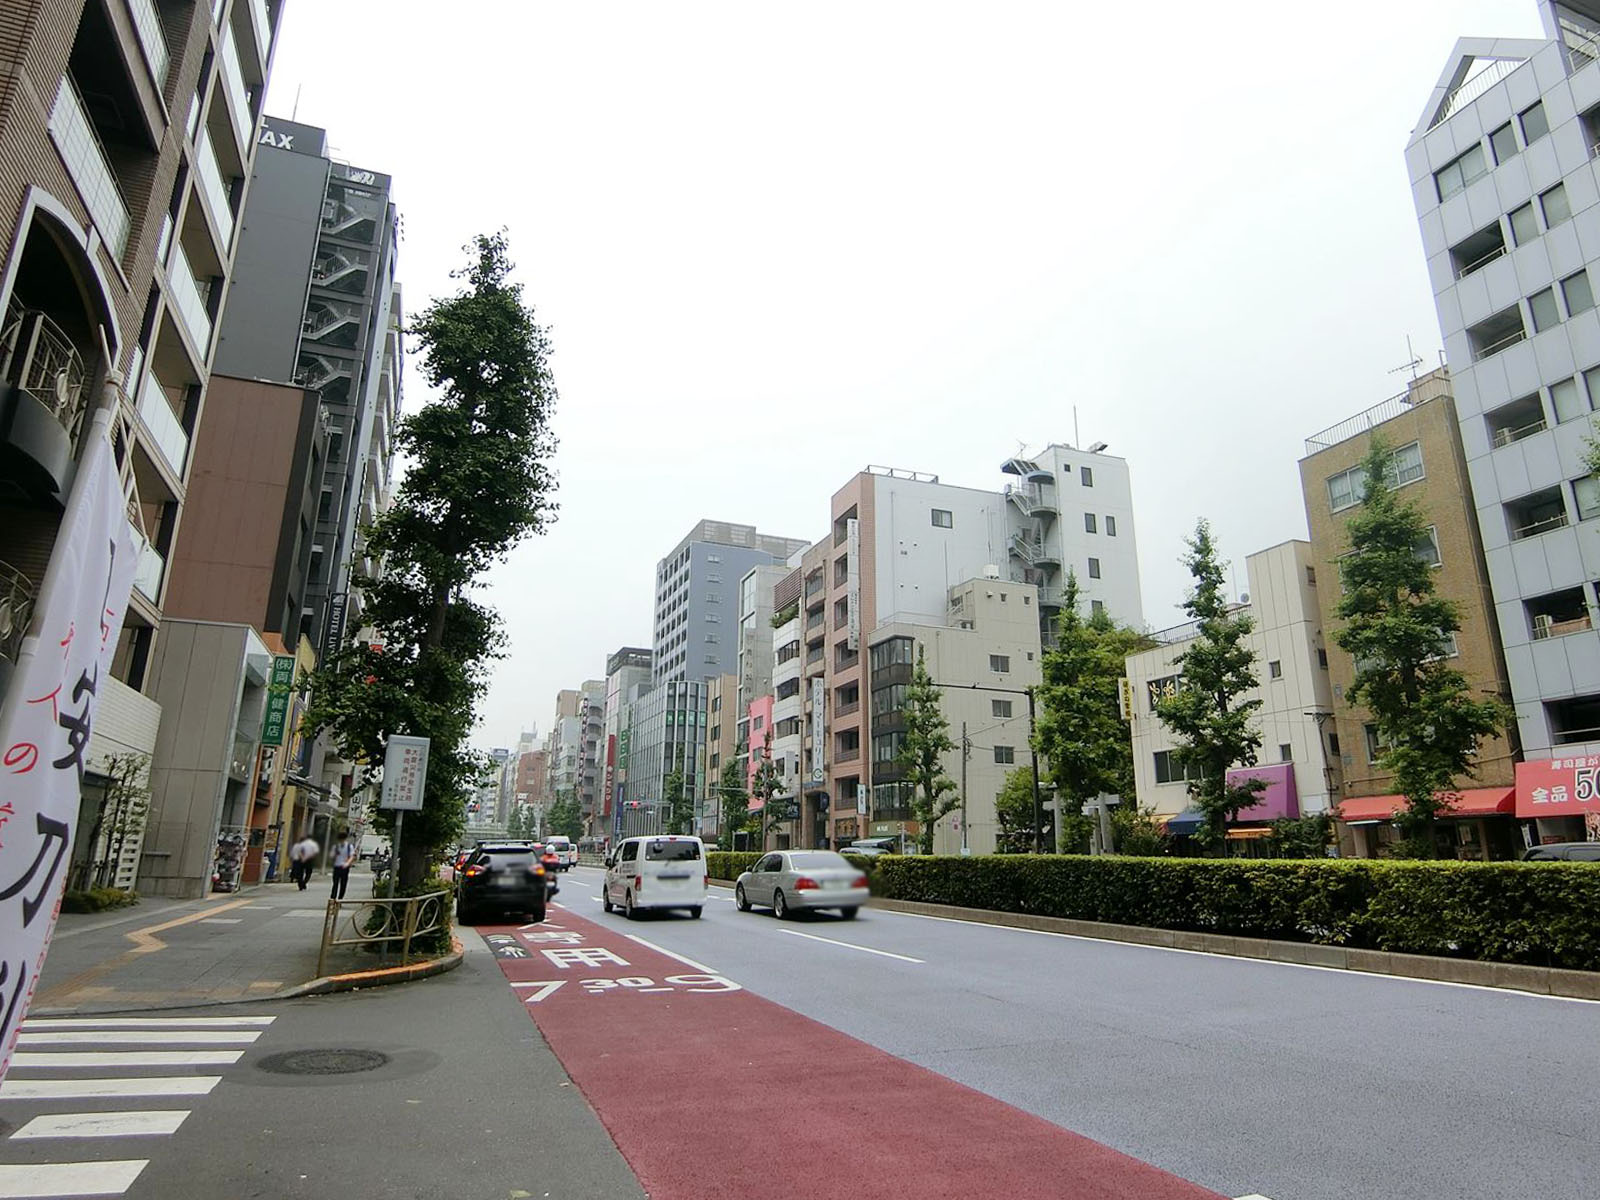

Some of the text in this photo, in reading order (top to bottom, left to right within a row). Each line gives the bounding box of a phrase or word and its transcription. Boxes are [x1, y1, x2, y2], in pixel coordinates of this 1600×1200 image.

[329, 607, 342, 633] HOTEL
[266, 657, 293, 737] (株)両健商店
[813, 679, 824, 766] ホテル マーキュリー
[1531, 767, 1600, 804] 全品 5
